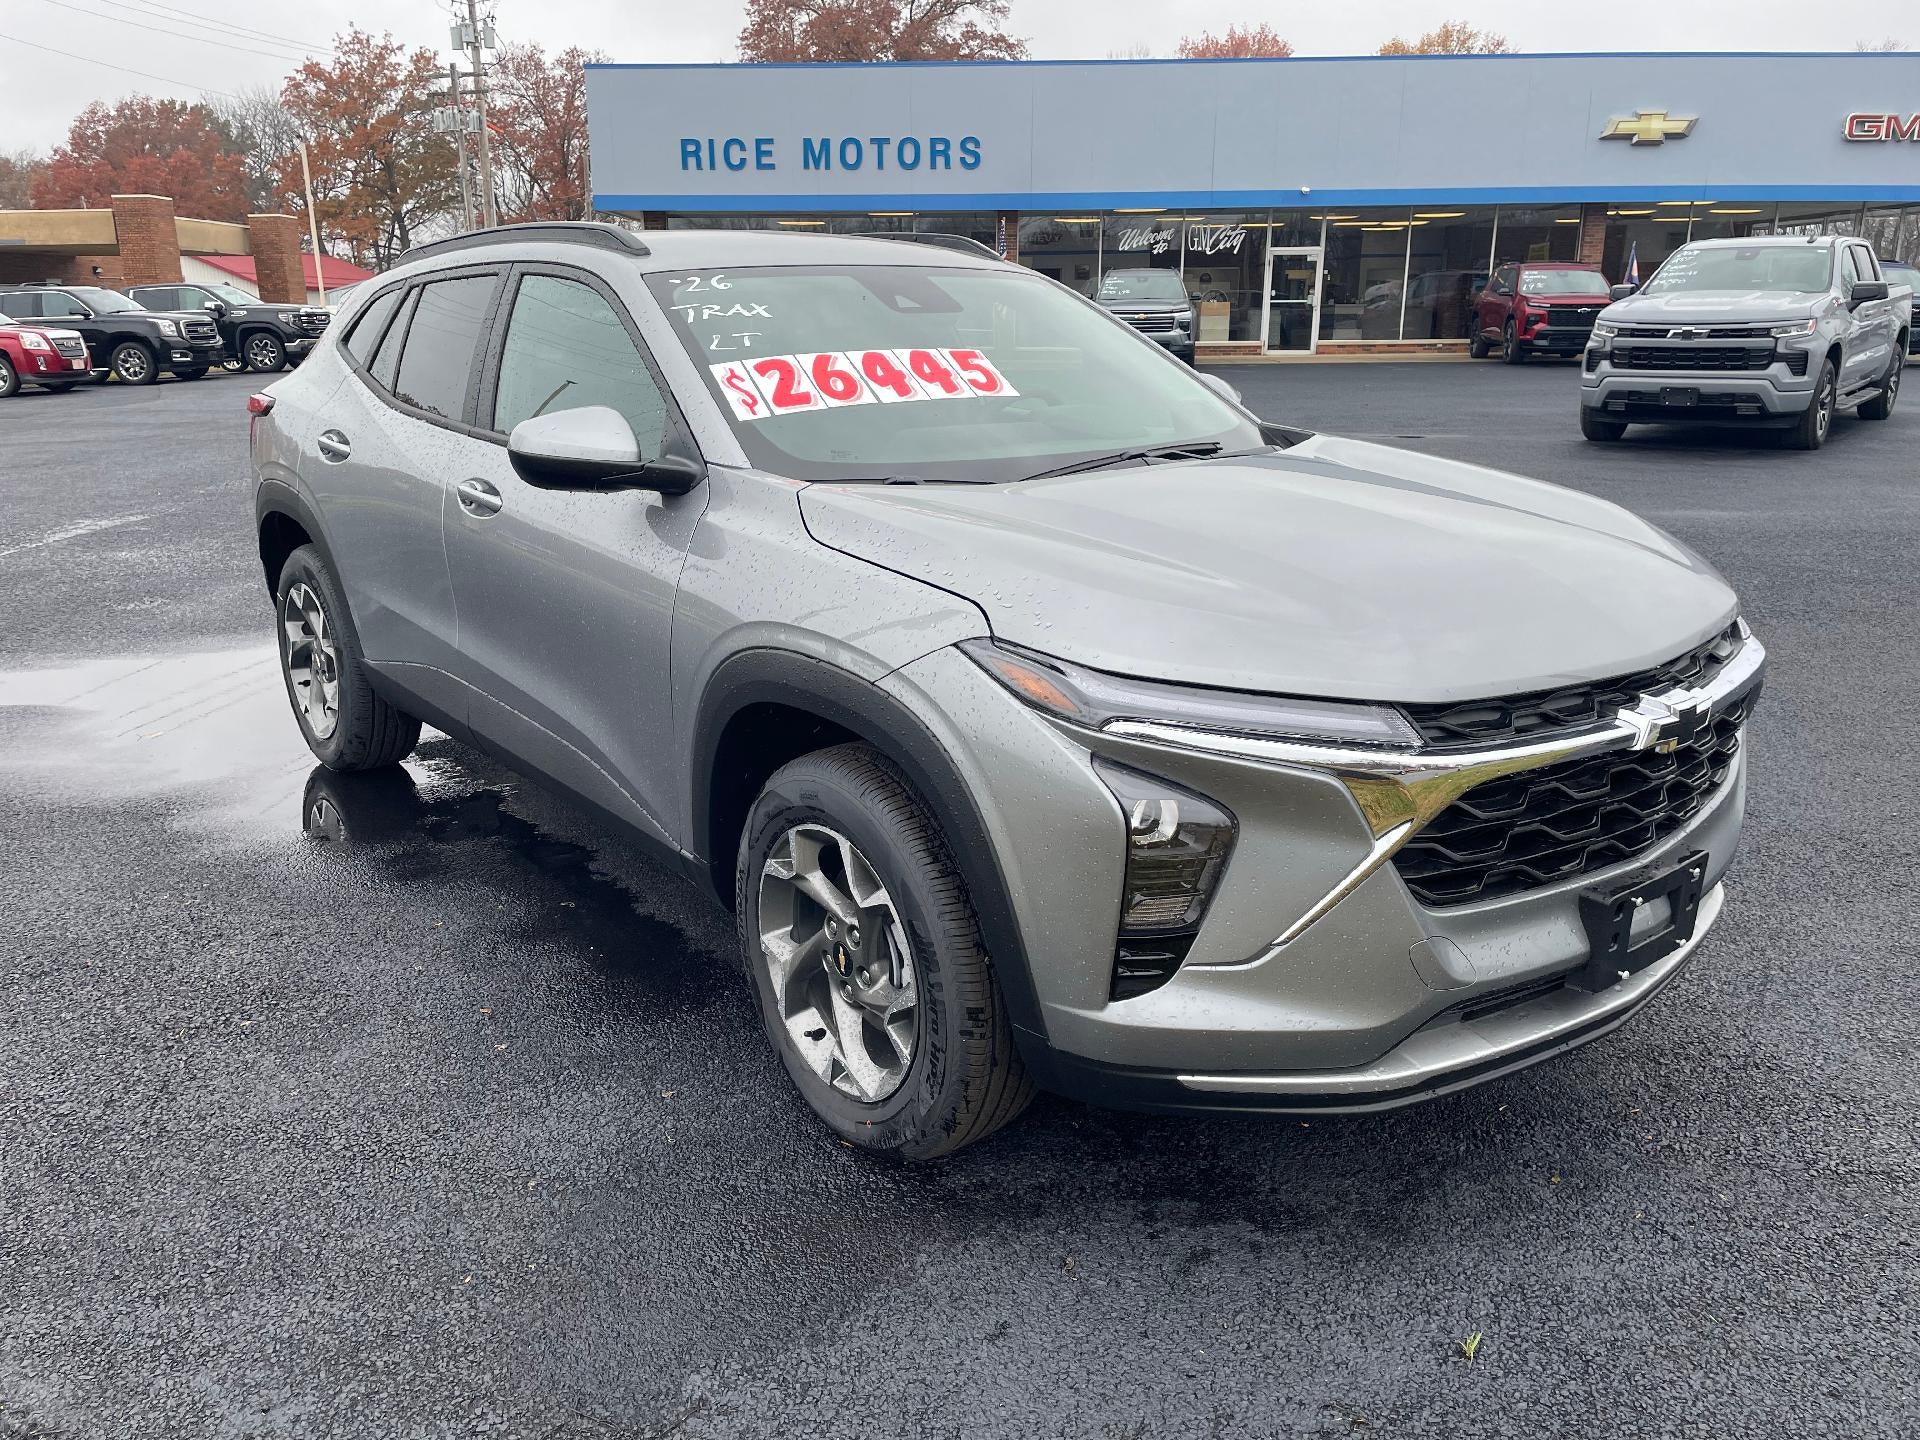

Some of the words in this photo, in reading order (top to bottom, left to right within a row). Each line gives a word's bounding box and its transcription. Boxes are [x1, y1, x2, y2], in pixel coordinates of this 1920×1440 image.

[680, 137, 776, 171] RICE
[802, 136, 981, 171] MOTORS
[1118, 226, 1176, 252] Welcome
[1152, 240, 1169, 255] to
[670, 303, 773, 323] TRAX
[710, 333, 762, 350] LT
[721, 350, 1003, 416] $26445
